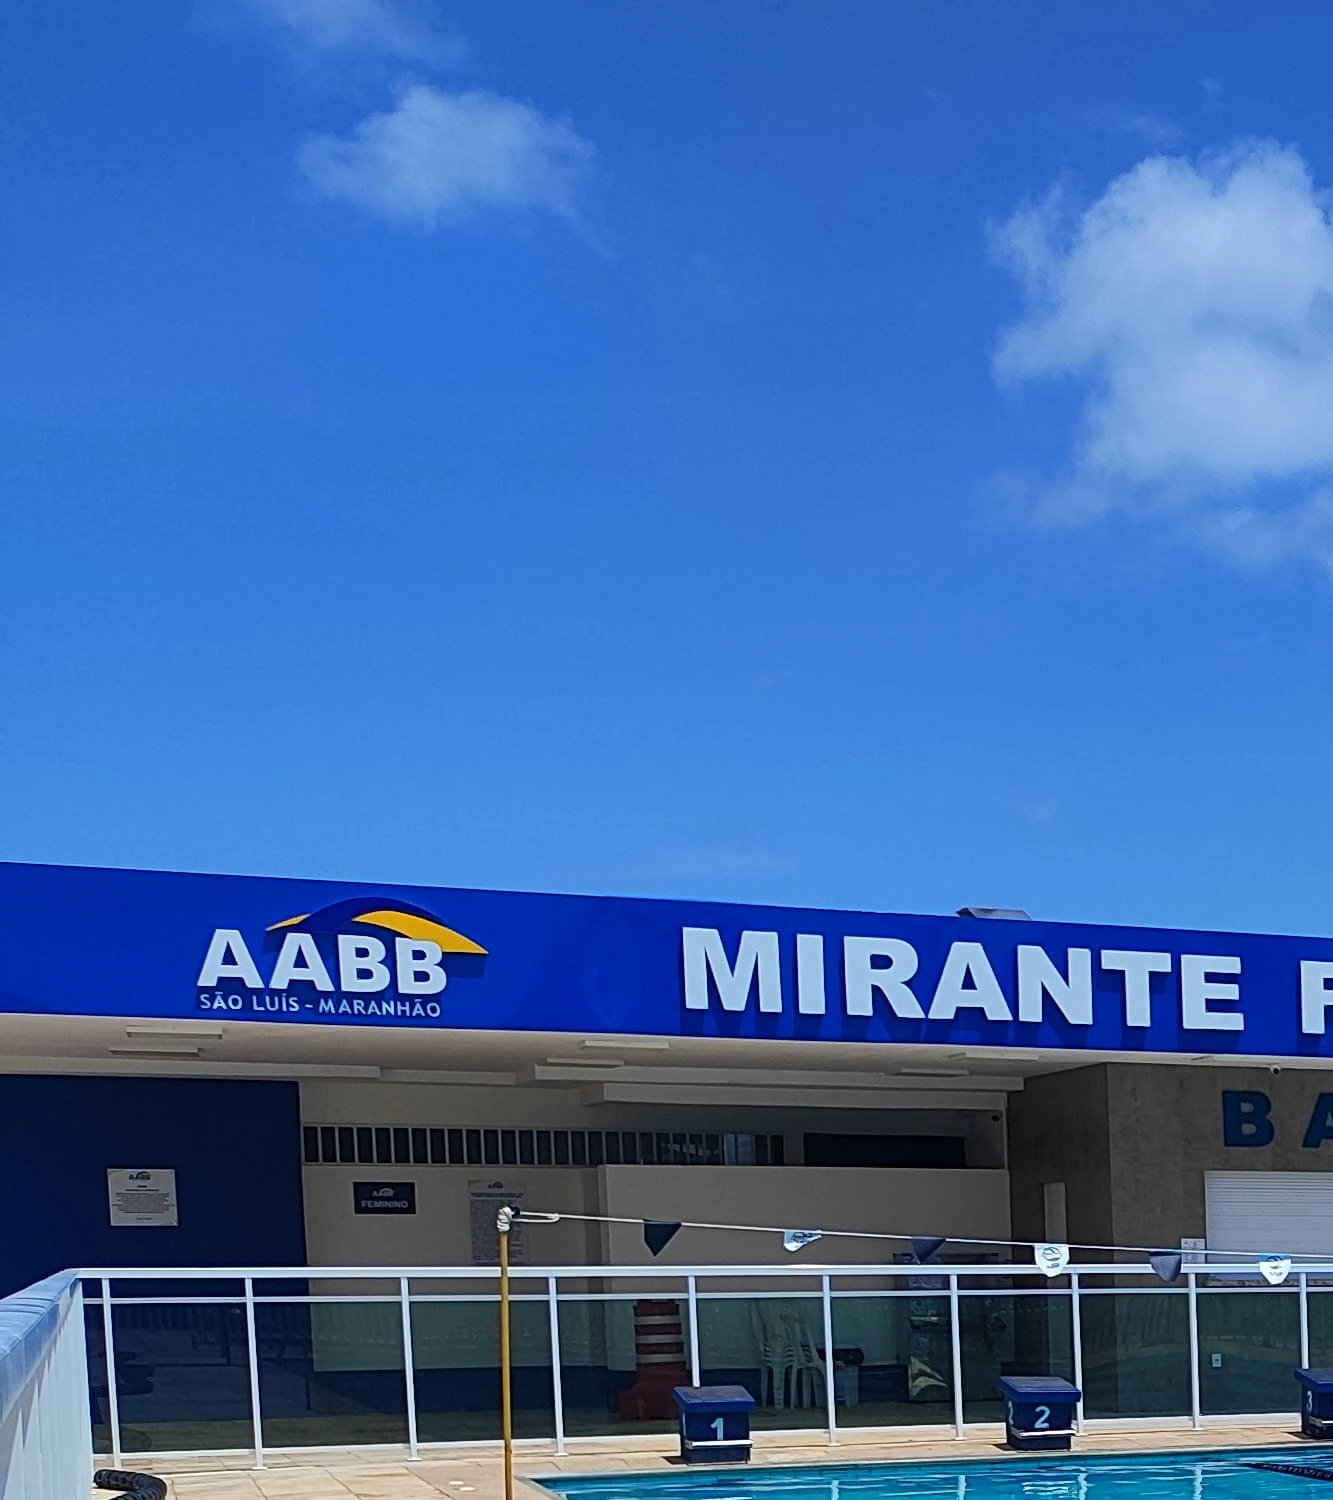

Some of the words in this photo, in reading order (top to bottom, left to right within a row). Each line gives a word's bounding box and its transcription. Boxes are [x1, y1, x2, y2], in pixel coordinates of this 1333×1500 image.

[197, 929, 447, 995] AABB
[682, 926, 1245, 1031] MIRANTE
[200, 991, 243, 1010] SÃO
[253, 993, 299, 1012] LUÍS
[318, 998, 441, 1017] MARANHÃO
[361, 1200, 409, 1209] FEMININO
[1306, 1390, 1313, 1413] 3
[710, 1417, 724, 1440] 1
[1034, 1405, 1051, 1429] 2
